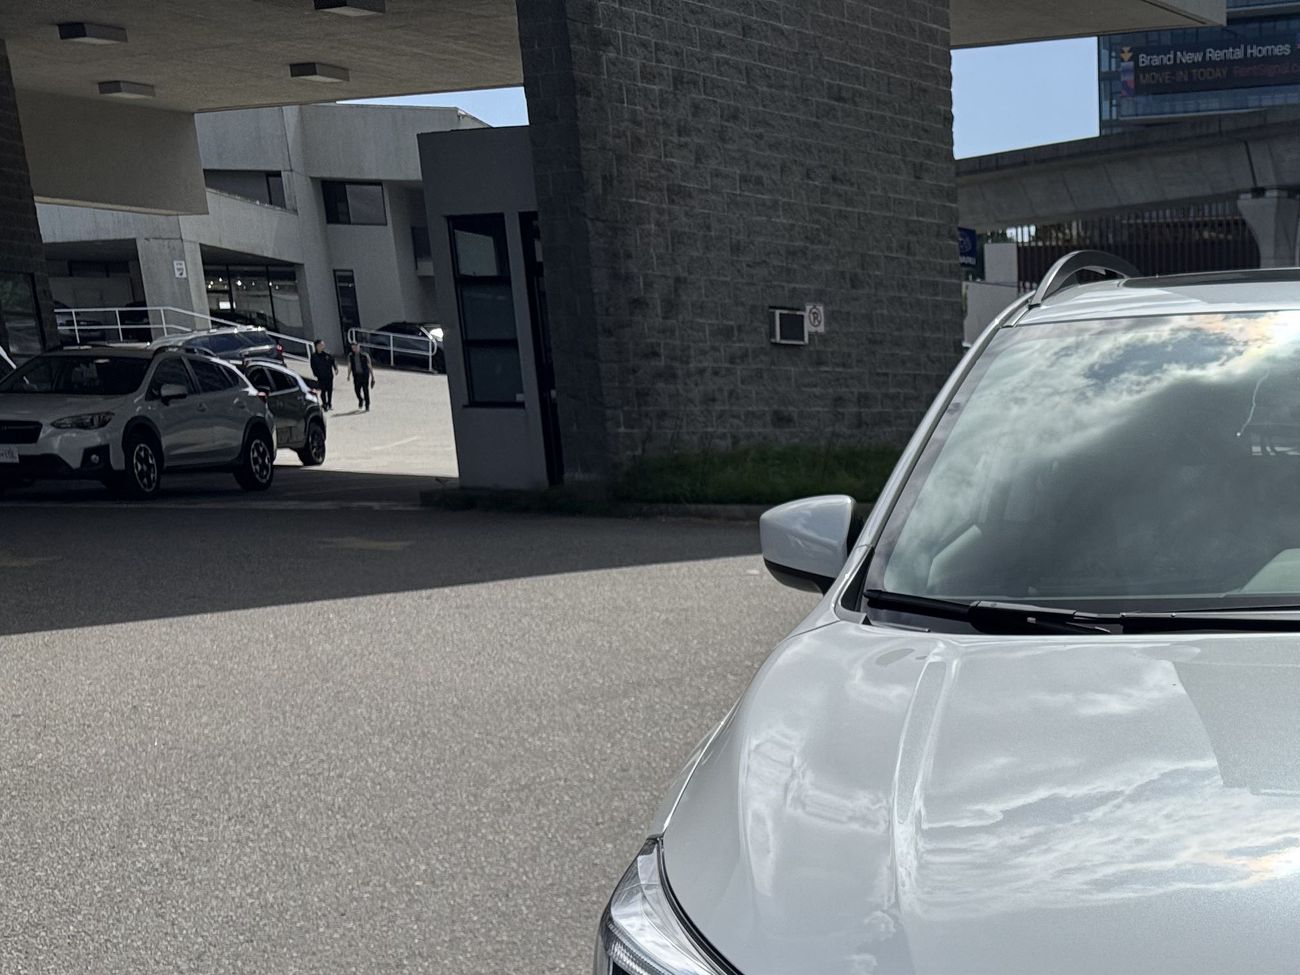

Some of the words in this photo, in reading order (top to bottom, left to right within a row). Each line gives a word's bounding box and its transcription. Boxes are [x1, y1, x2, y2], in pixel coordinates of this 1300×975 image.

[1138, 51, 1174, 67] Brand
[1176, 49, 1203, 63] New
[1205, 44, 1244, 60] Rental
[1246, 42, 1291, 58] Homes
[1139, 70, 1189, 85] MOVE-IN
[1191, 66, 1229, 81] TODAY
